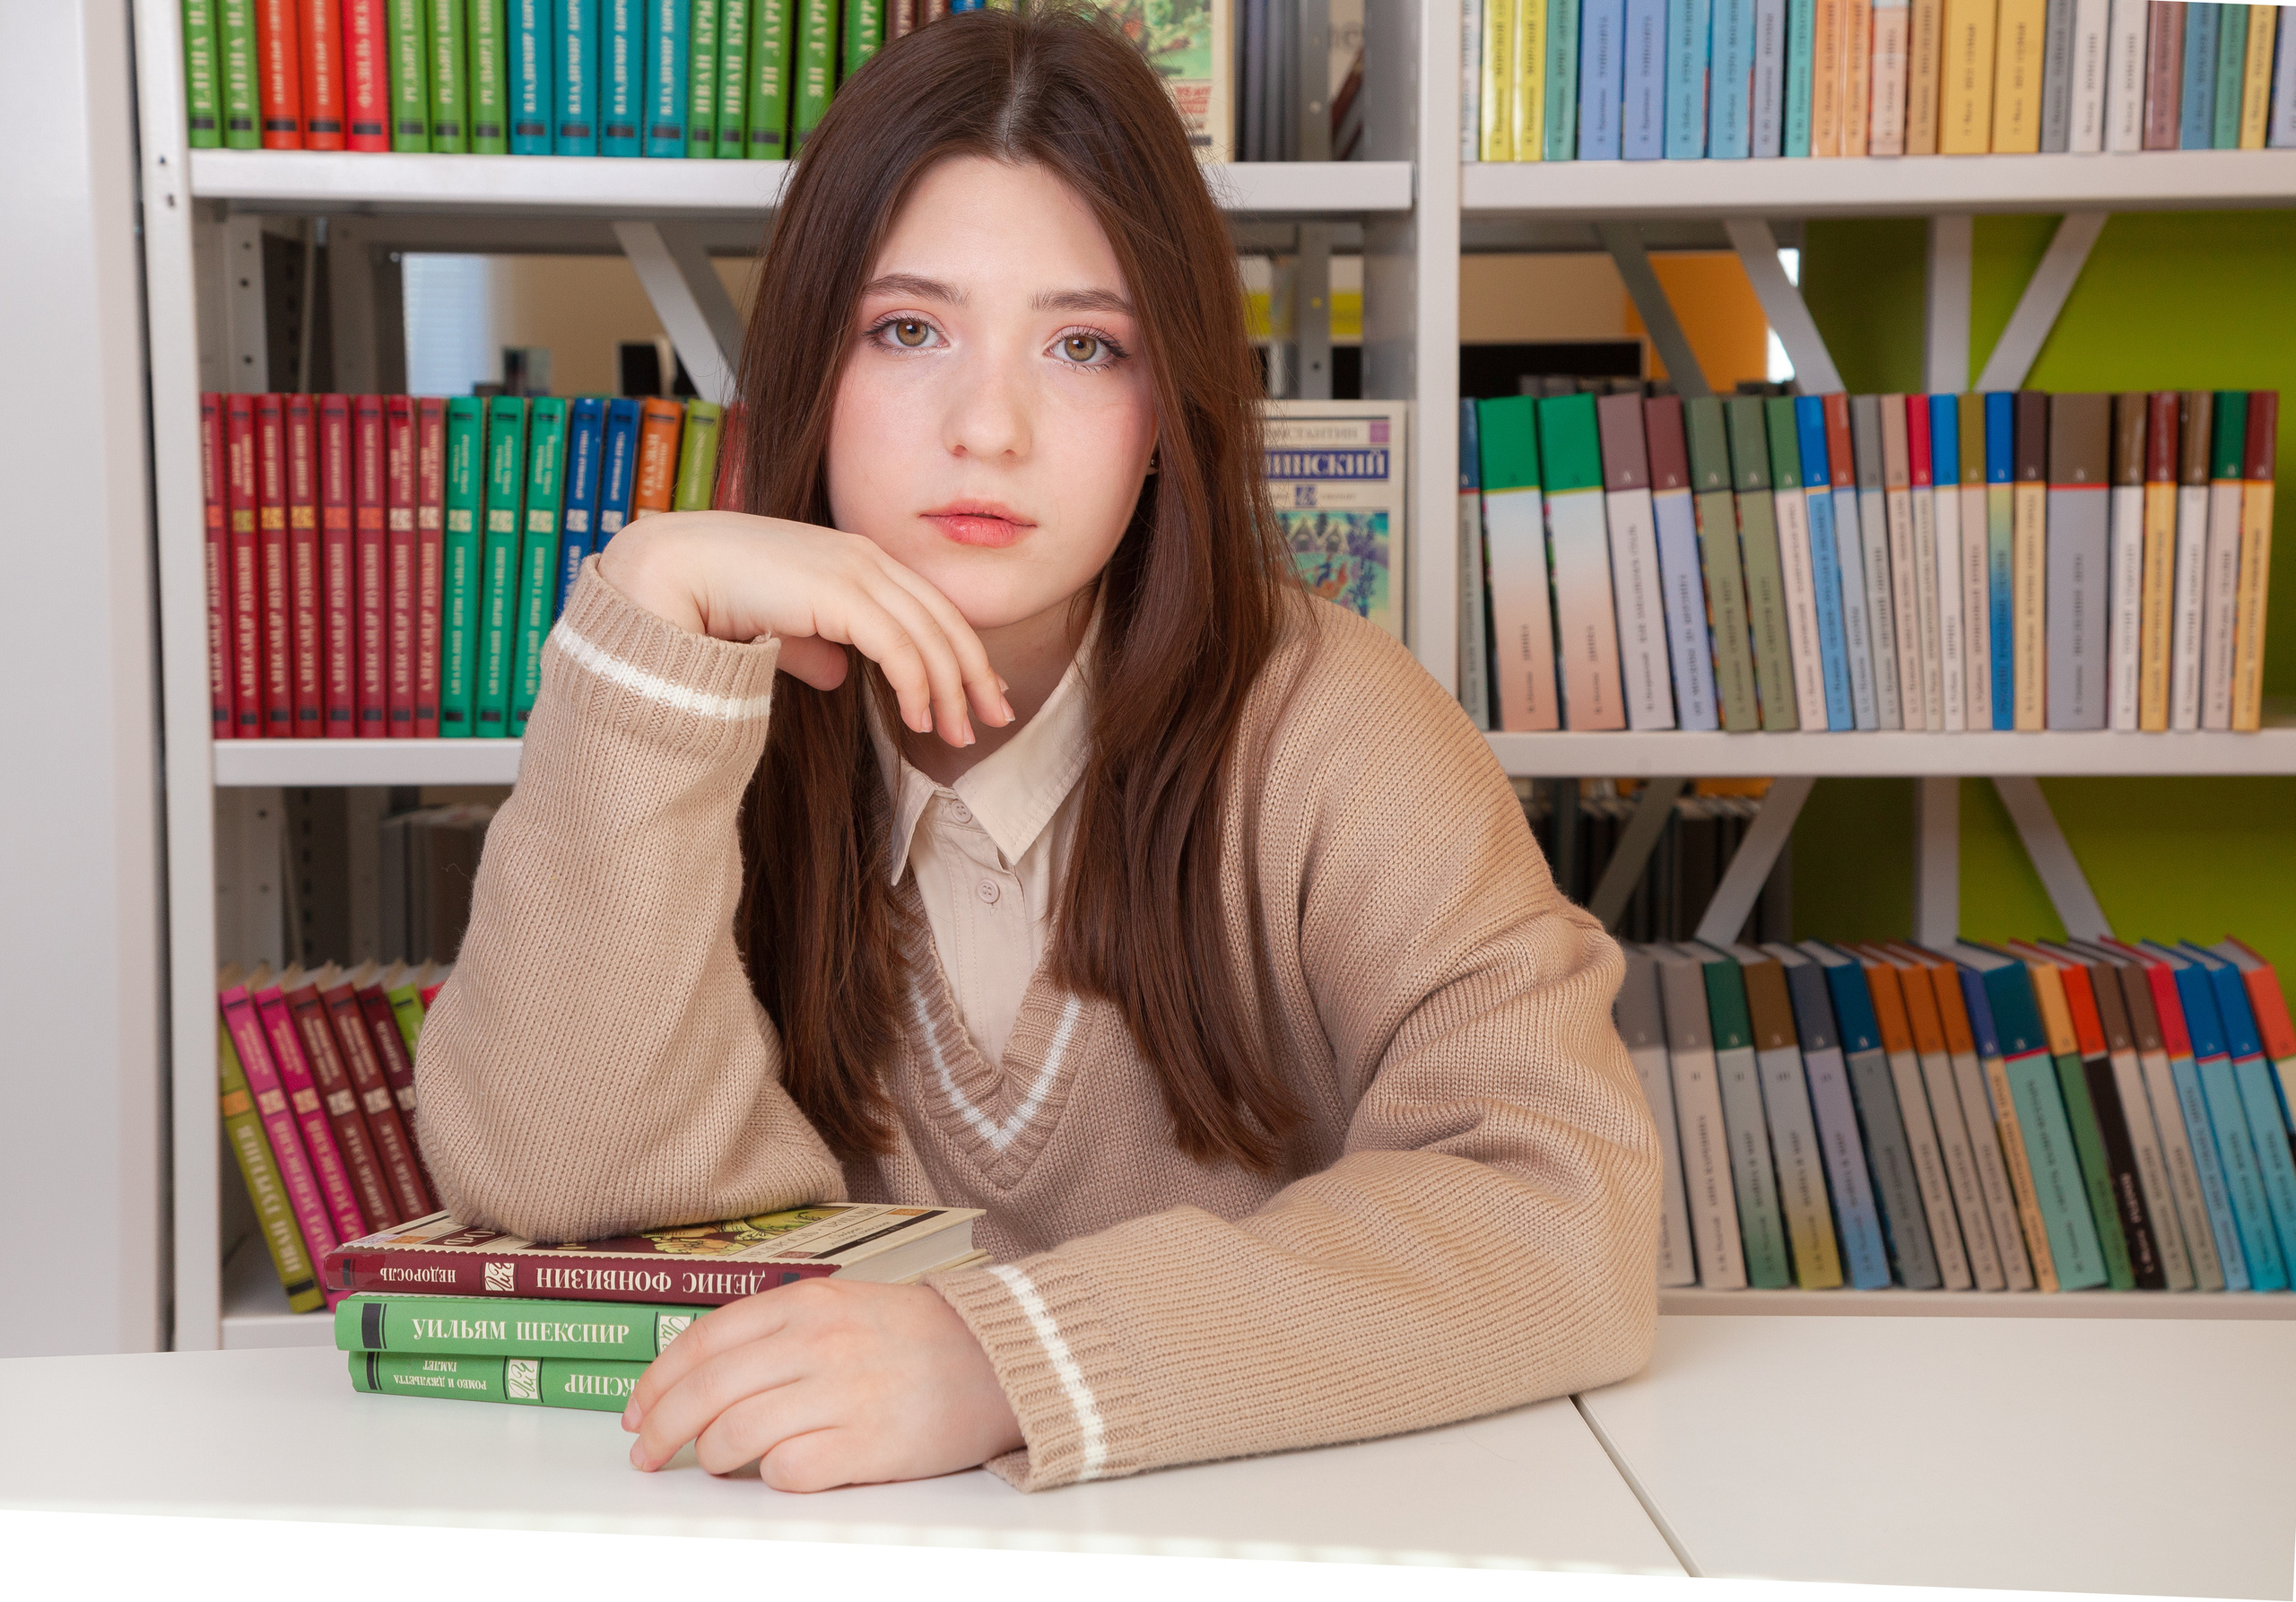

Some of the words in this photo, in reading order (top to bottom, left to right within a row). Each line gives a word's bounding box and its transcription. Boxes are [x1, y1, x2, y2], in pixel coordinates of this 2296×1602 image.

[1265, 449, 1385, 476] ИНСКИЙ
[238, 1123, 281, 1215] ТУРГЕНЕВ
[271, 1219, 300, 1273] ИВАН
[380, 1267, 457, 1283] НЕДОРОСЛЬ
[535, 1267, 672, 1293] ФОНВИЗИН
[683, 1270, 766, 1295] ДЕНИС
[412, 1319, 507, 1340] УИЛЬЯМ
[516, 1321, 630, 1345] ШЕКСПИР
[422, 1360, 457, 1372] ГАМЛЕТ
[393, 1374, 447, 1389] ДЖУЛЬЕТТА
[448, 1378, 455, 1388] И
[457, 1378, 487, 1390] РОМЕО
[564, 1373, 640, 1397] КСПИР
